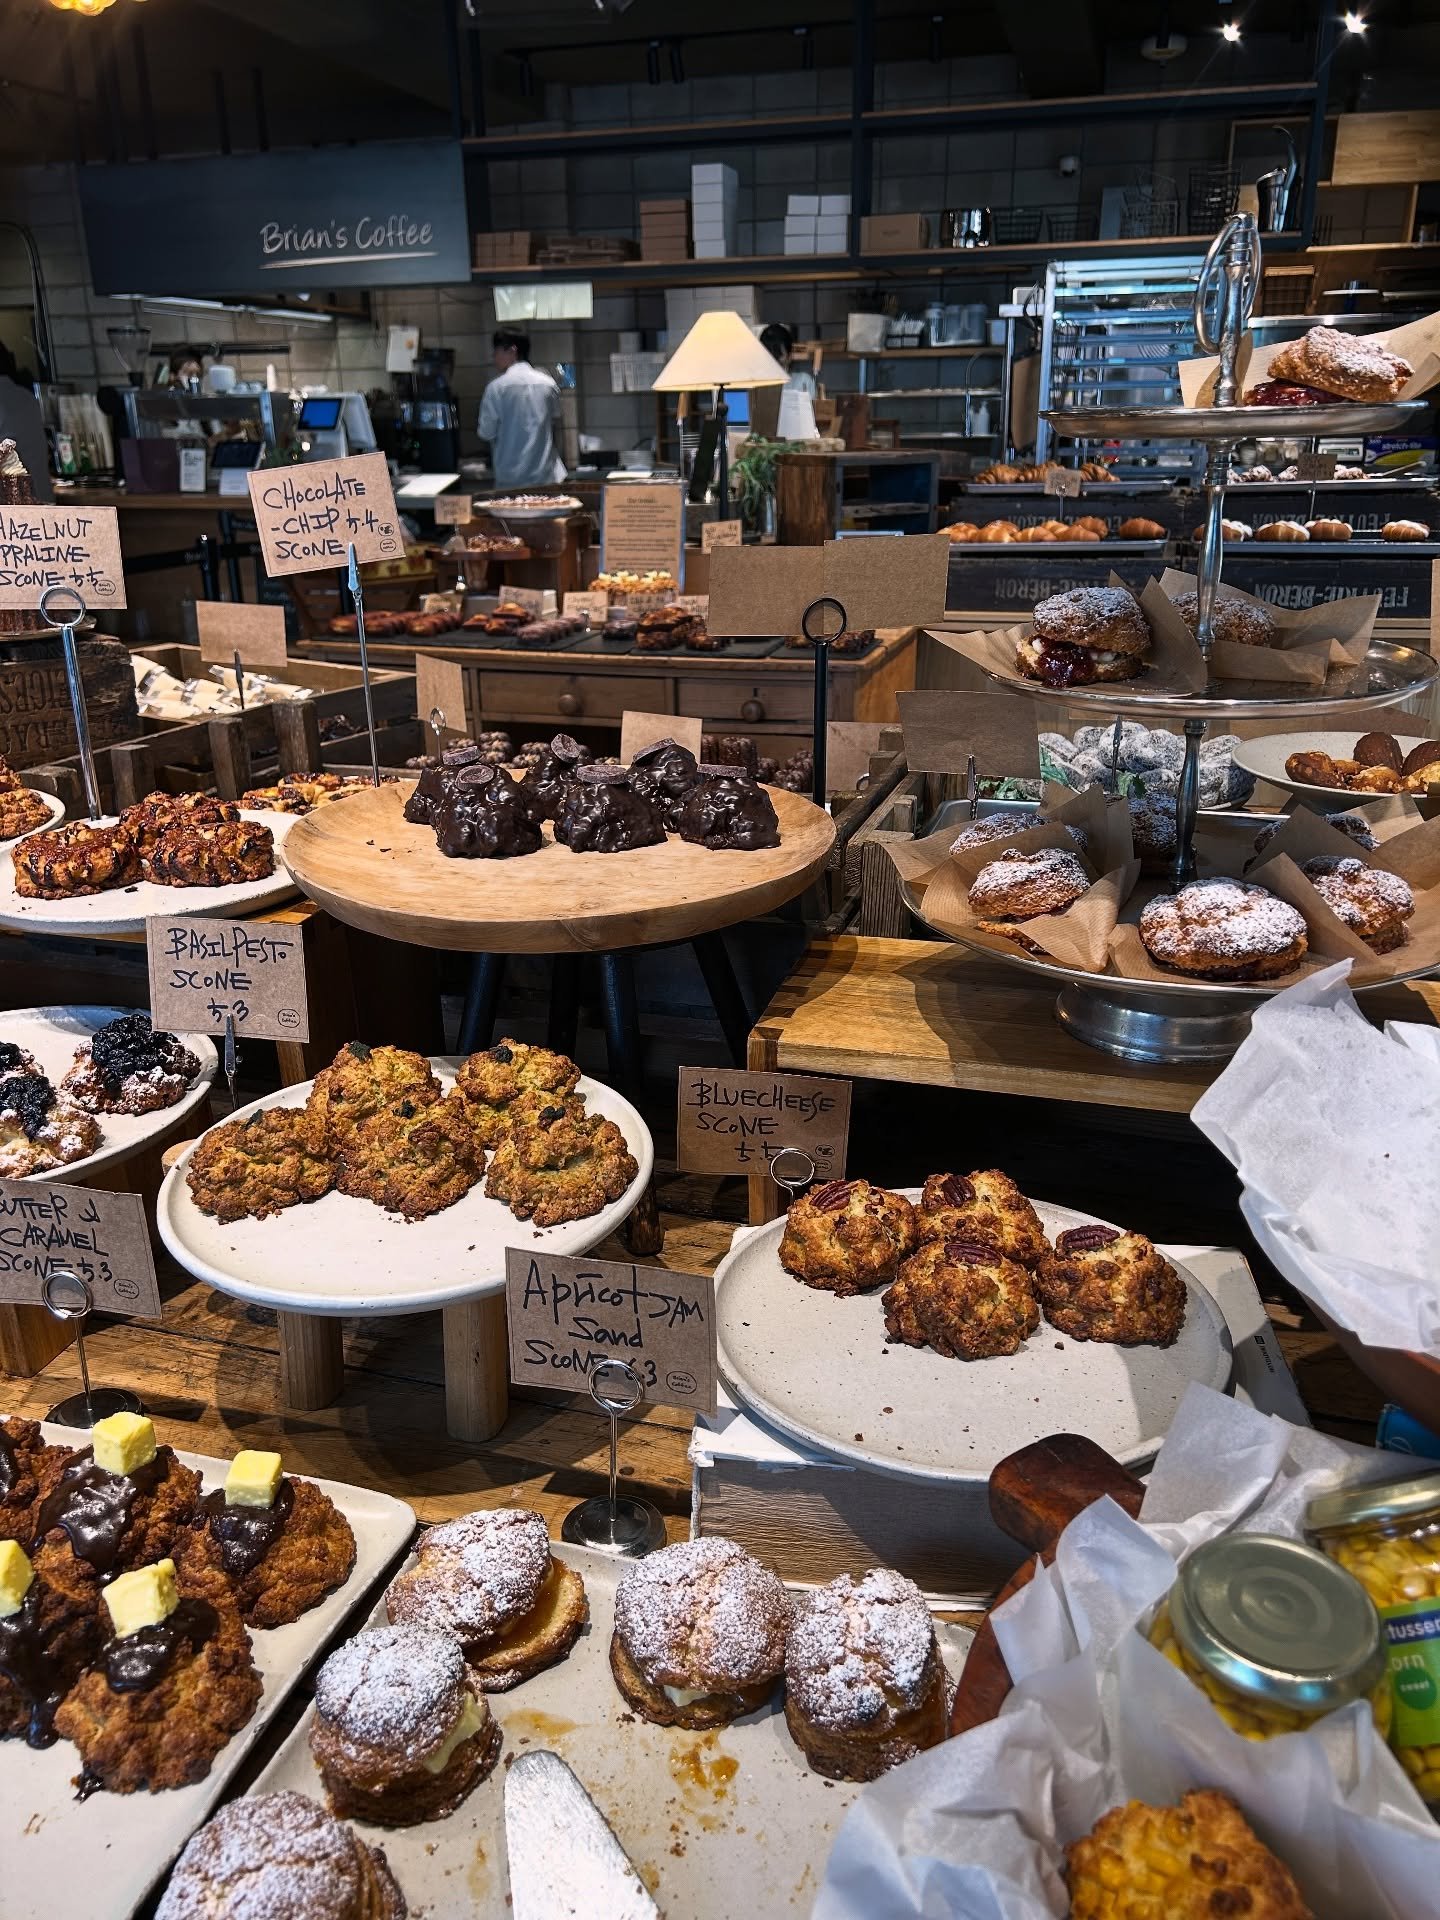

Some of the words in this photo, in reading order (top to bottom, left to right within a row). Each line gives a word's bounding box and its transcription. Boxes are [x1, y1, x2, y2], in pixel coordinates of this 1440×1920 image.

[259, 217, 349, 254] Brian's
[355, 213, 433, 250] Coffee
[263, 471, 366, 511] CHOCOLATE
[0, 544, 91, 569] PRALINE
[275, 538, 346, 560] SCONE
[0, 569, 65, 588] SCONE
[169, 968, 252, 991] SCONE
[696, 1111, 779, 1137] SCONE
[0, 1221, 110, 1257] CARAMEL
[0, 1251, 73, 1280] SCONE
[568, 1316, 643, 1348] Sand
[1387, 1654, 1425, 1673] orn
